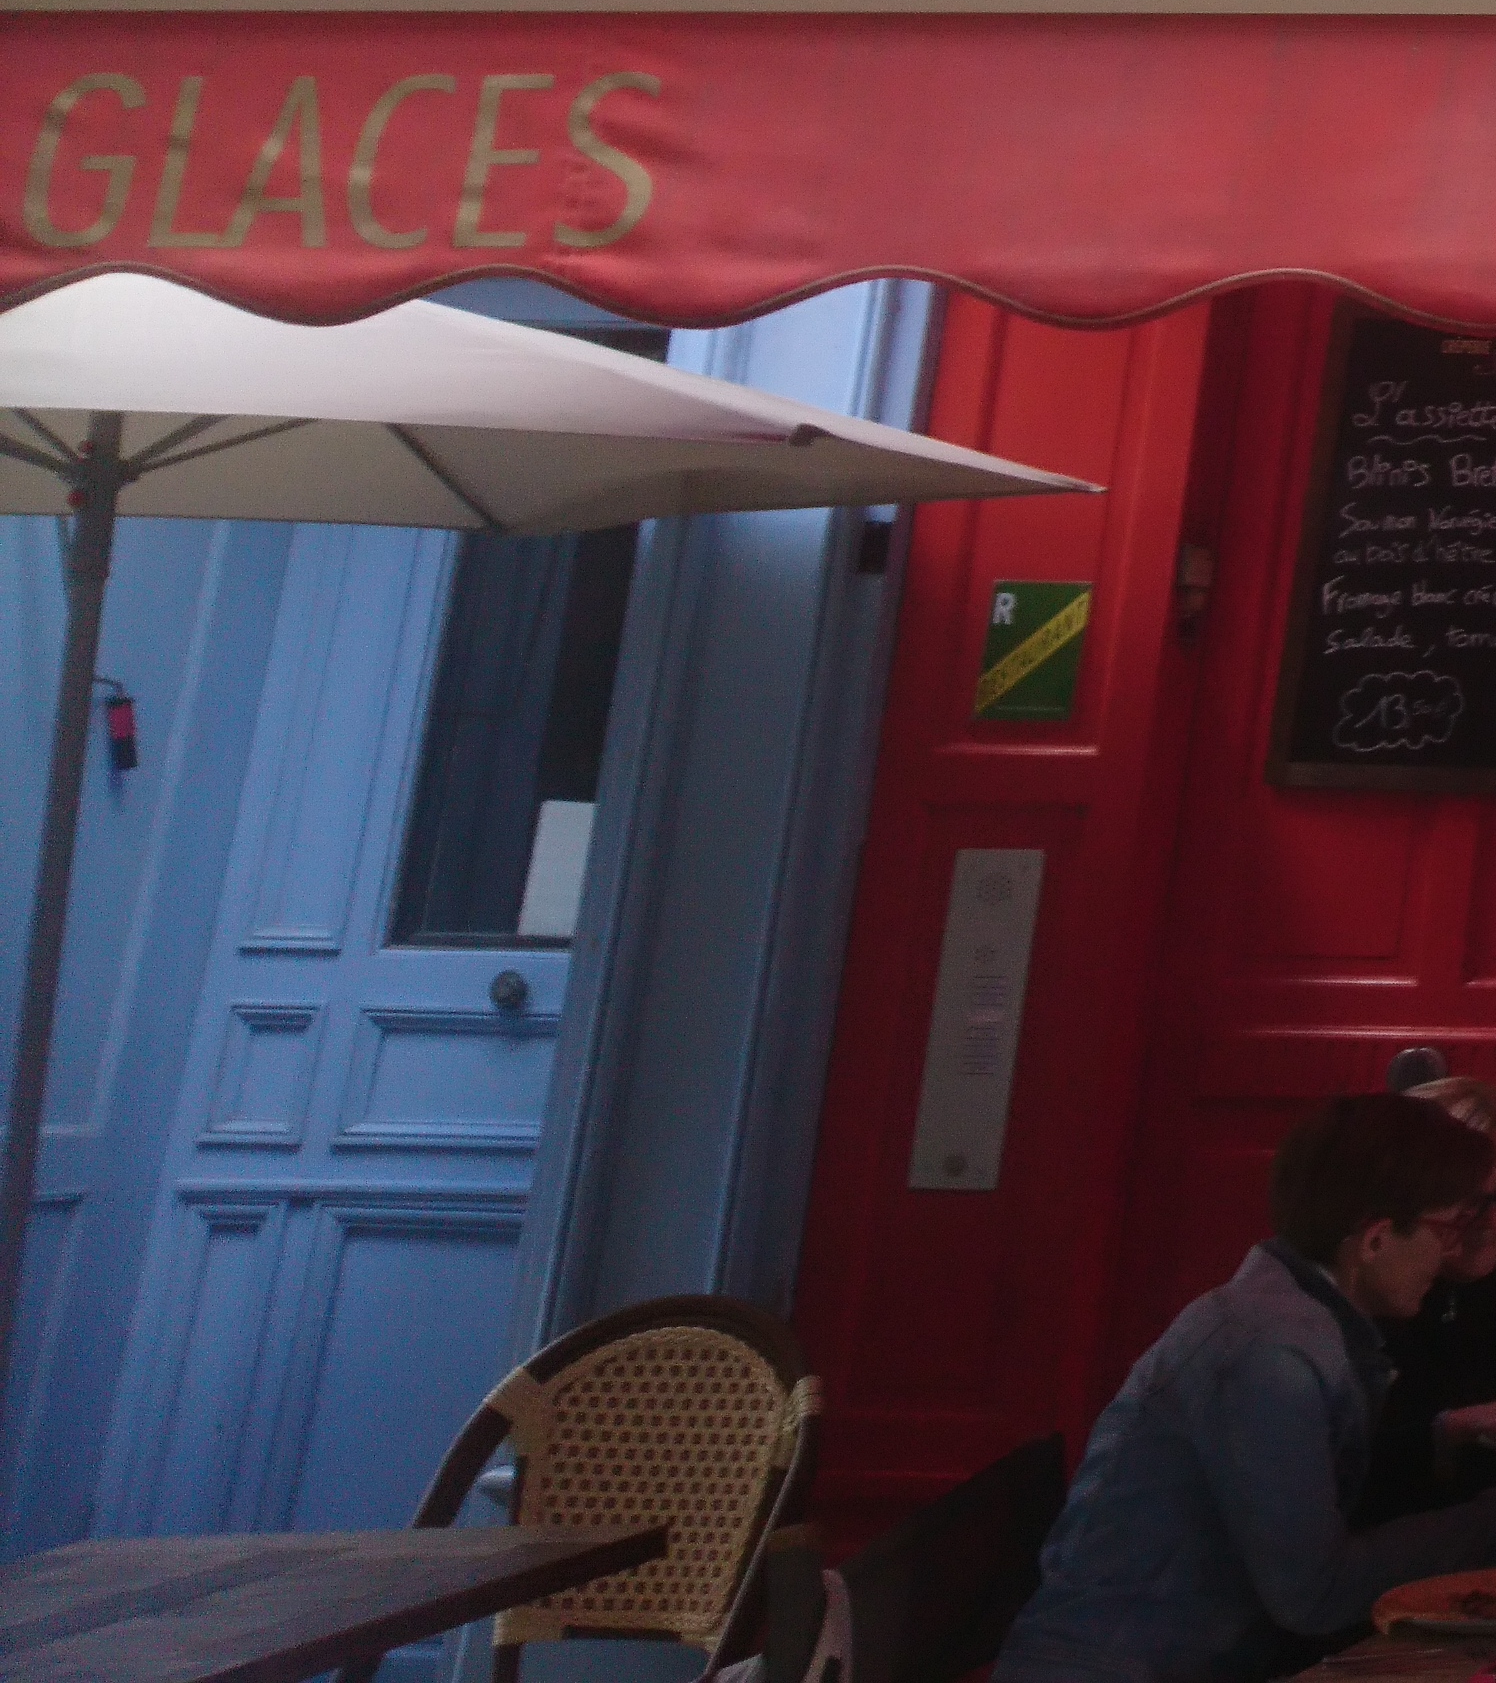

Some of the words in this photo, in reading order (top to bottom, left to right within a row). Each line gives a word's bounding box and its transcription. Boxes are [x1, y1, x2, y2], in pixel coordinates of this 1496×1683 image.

[20, 71, 662, 250] GLACES
[1346, 454, 1432, 490] Blinis
[991, 591, 1017, 625] R
